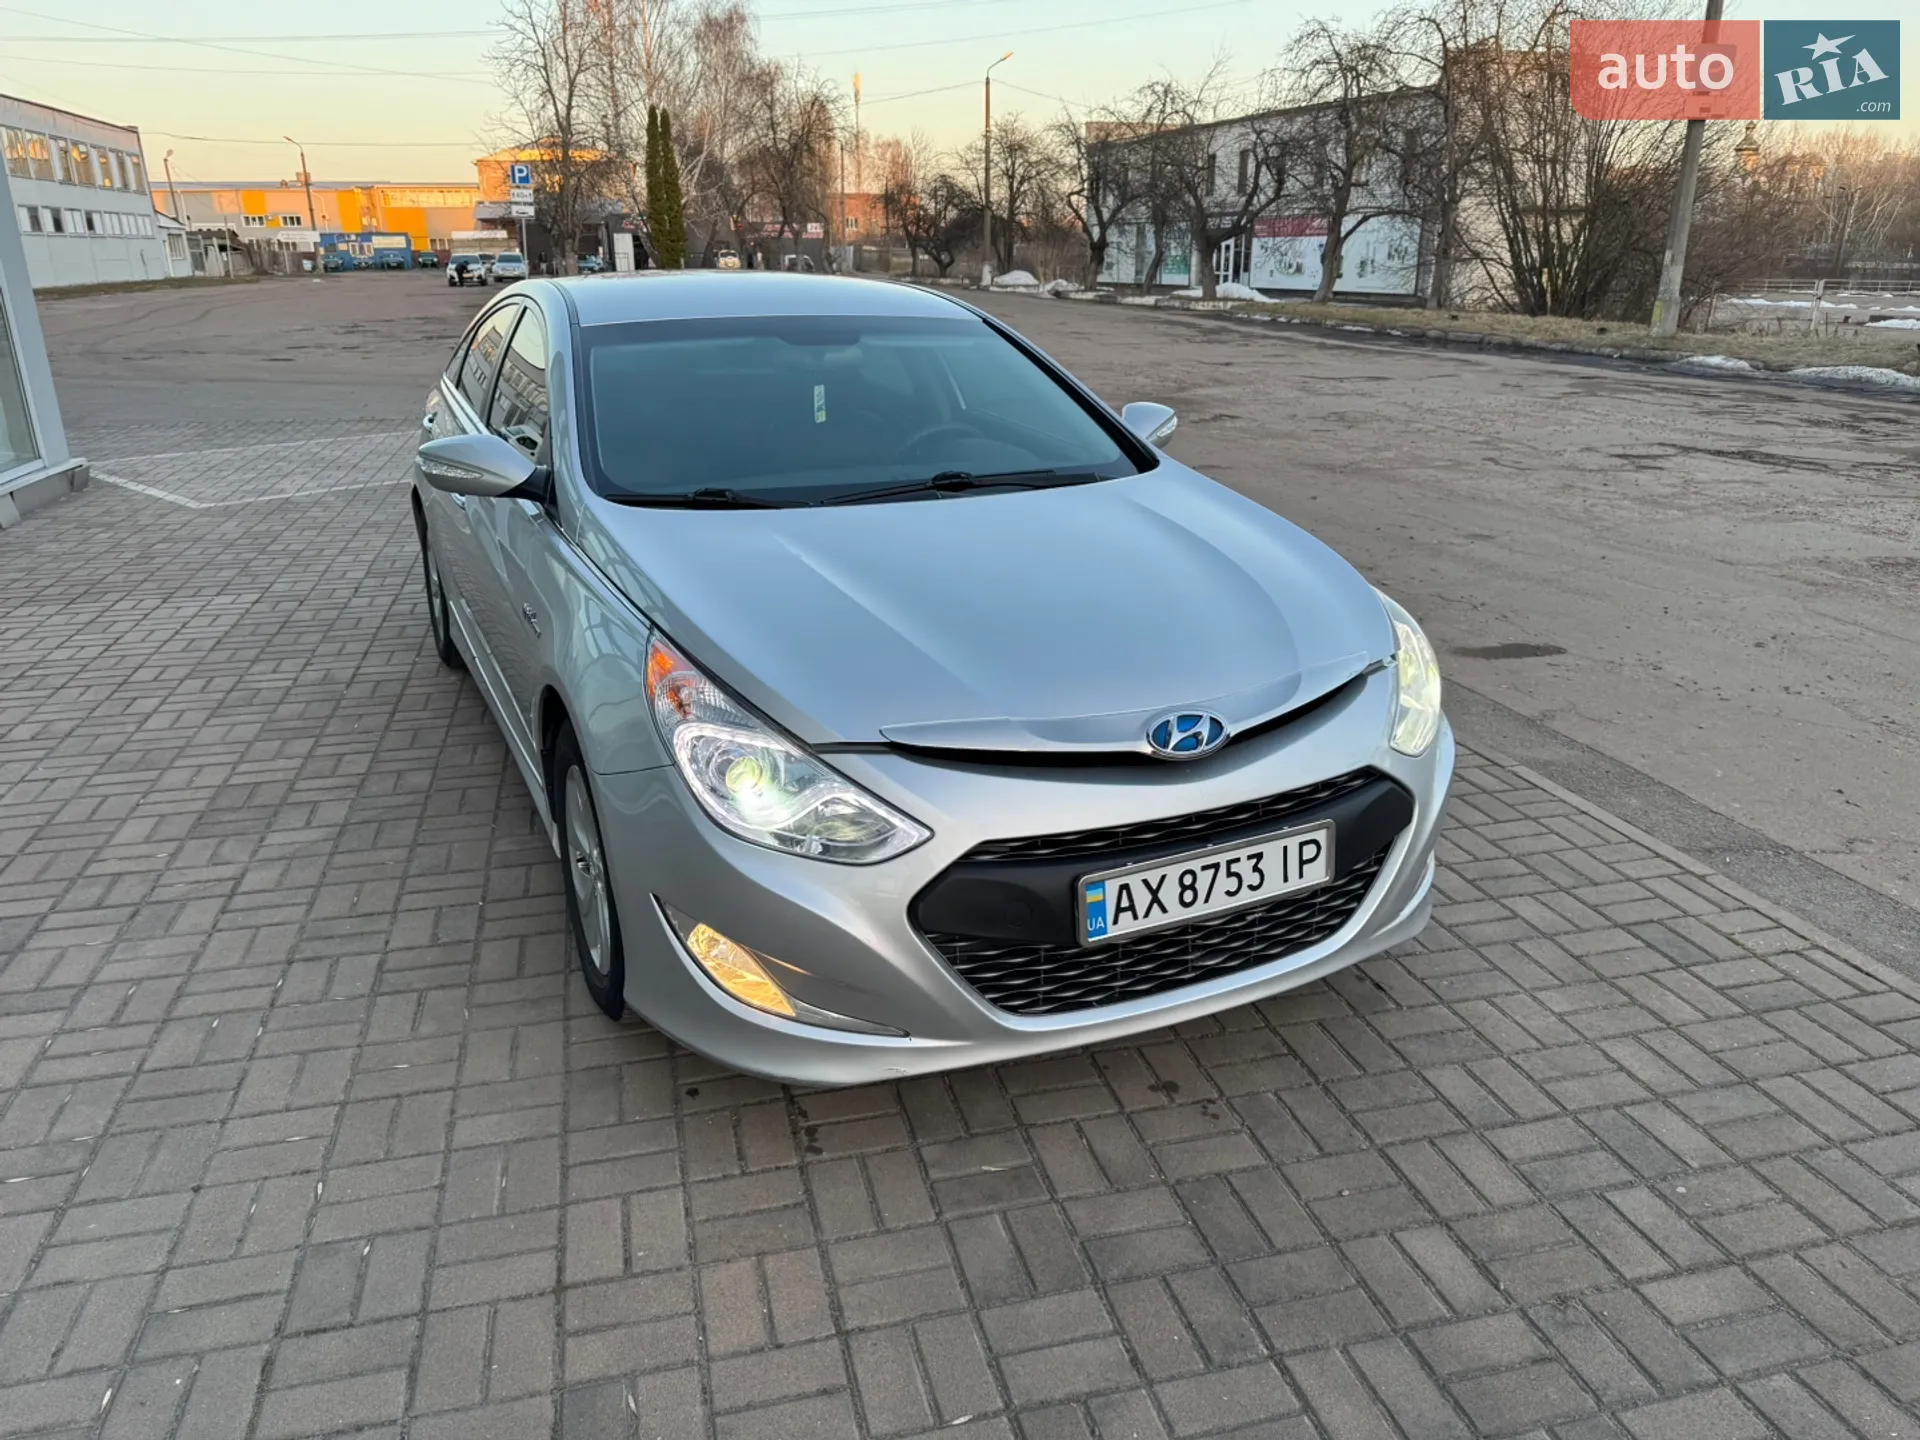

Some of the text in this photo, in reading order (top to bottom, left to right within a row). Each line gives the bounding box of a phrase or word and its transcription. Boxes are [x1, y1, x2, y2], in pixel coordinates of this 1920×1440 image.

[514, 165, 528, 184] P
[1111, 838, 1323, 926] AX 8753 IP
[1087, 916, 1105, 931] UA
